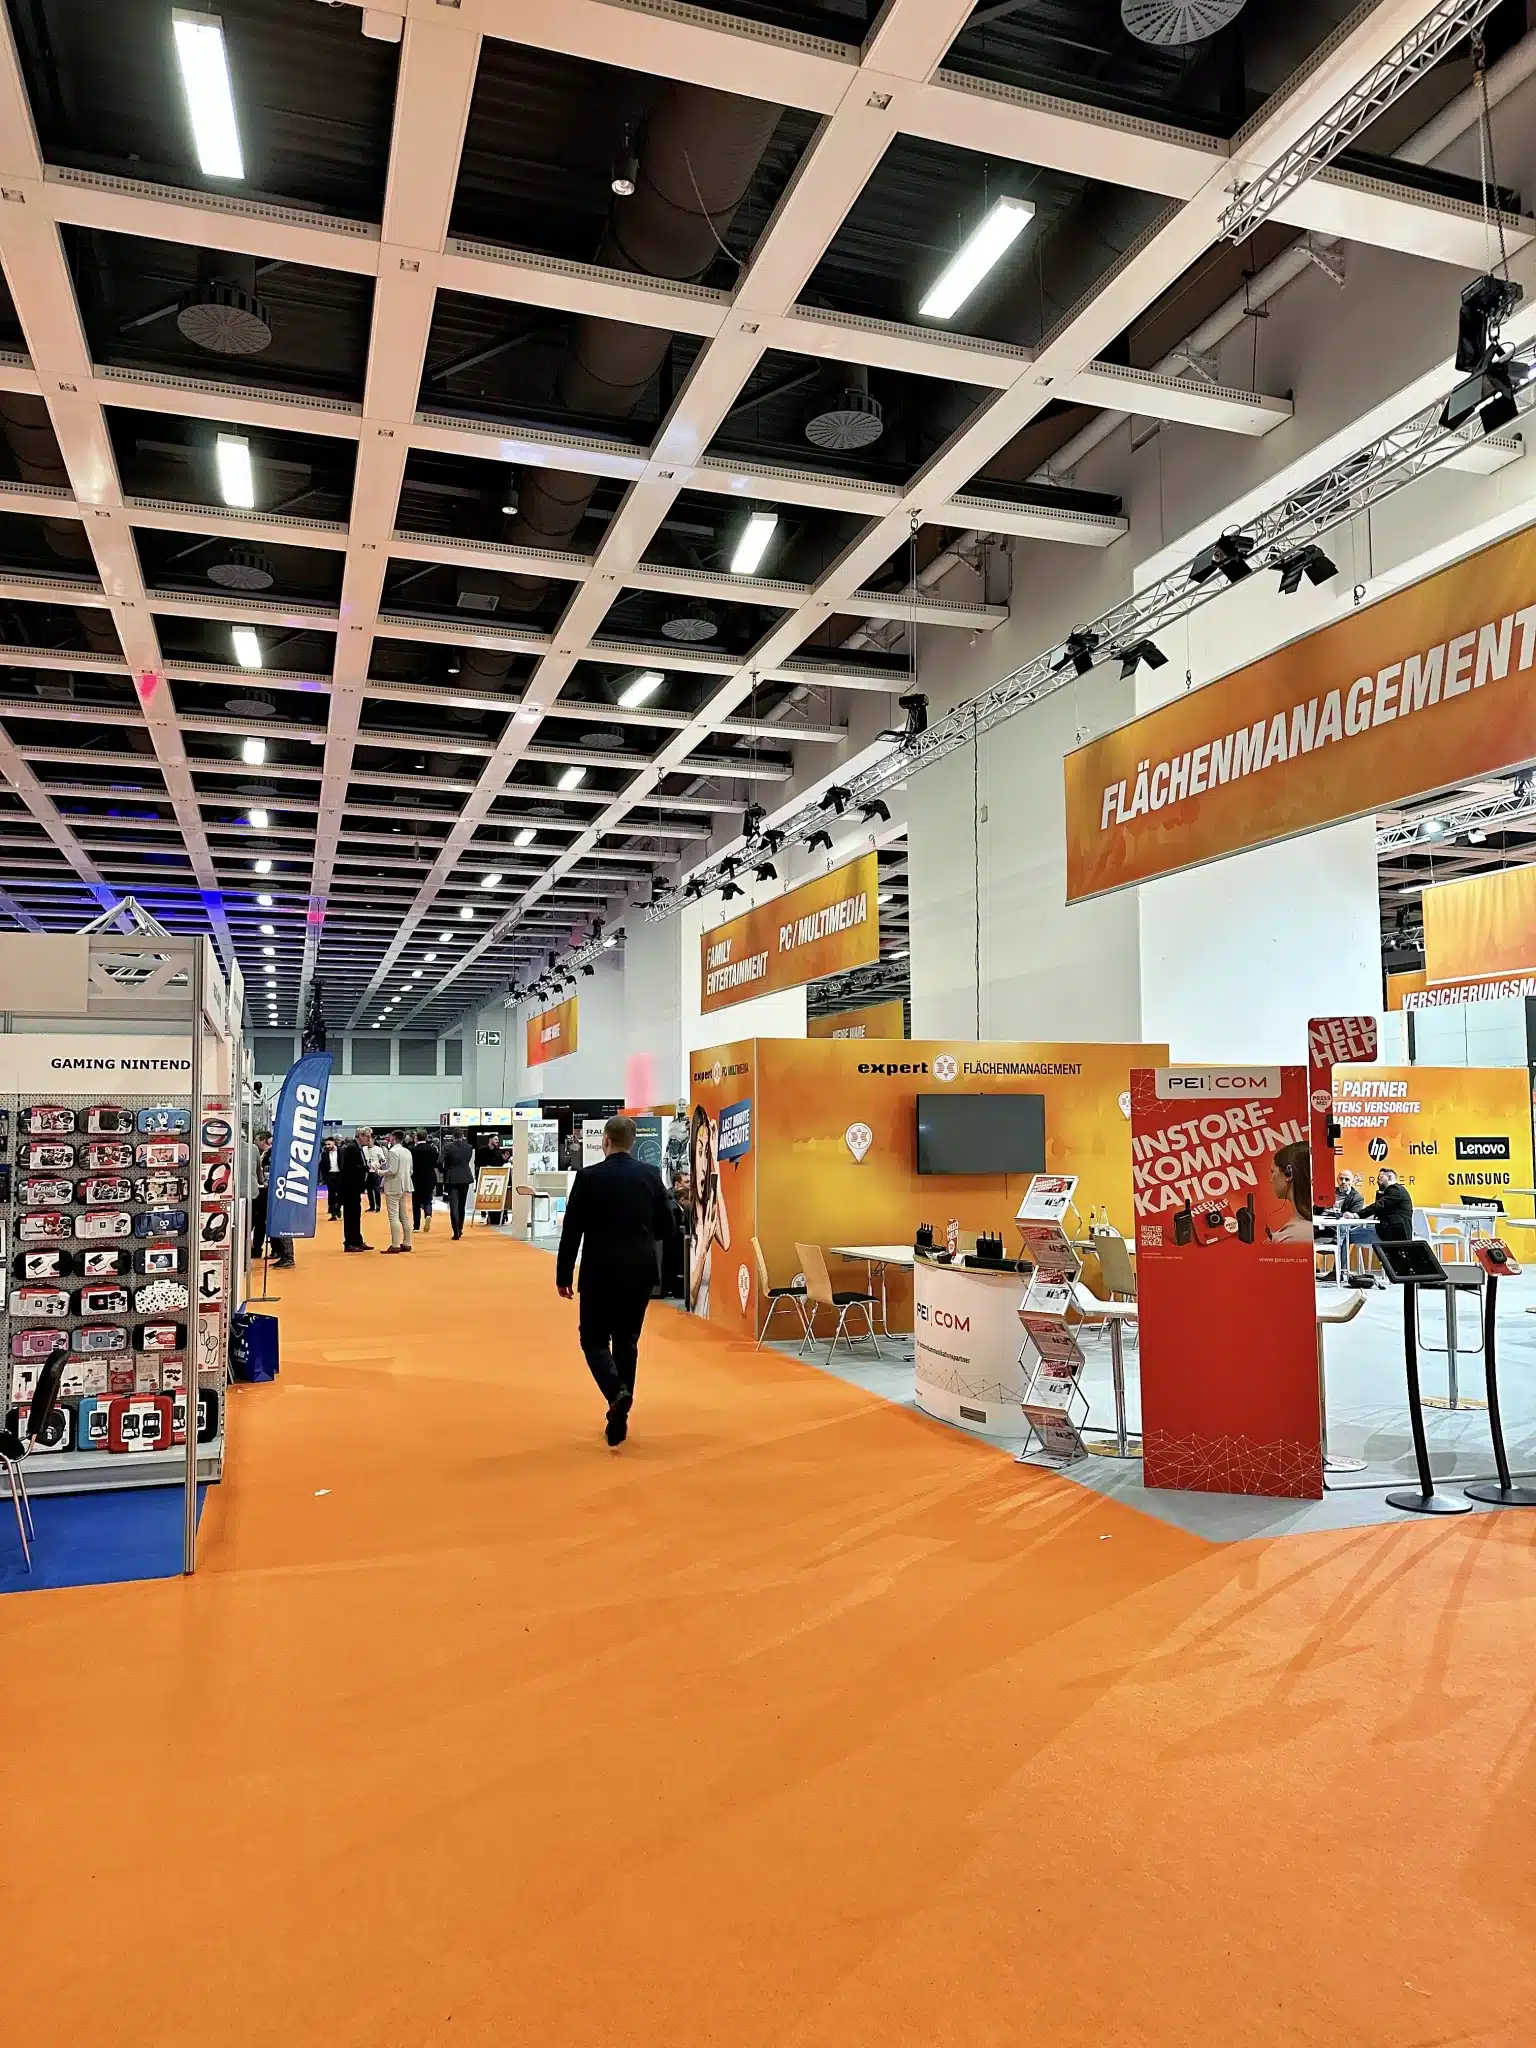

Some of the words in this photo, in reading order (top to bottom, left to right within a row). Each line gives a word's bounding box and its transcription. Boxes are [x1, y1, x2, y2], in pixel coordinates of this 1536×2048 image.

[1100, 603, 1536, 830] FLÄCHENMANAGEMENT
[778, 892, 867, 953] PC/MULTIMEDIA
[706, 938, 732, 970] FAMILY
[706, 951, 769, 996] ENTERTAINMENT
[1402, 977, 1536, 1011] VERSICHERUNGSM
[1308, 1016, 1377, 1049] NEED
[1311, 1031, 1377, 1068] HELP
[51, 1058, 115, 1070] GAMING
[121, 1059, 191, 1070] NINTEND
[857, 1061, 928, 1076] expert
[963, 1060, 1082, 1075] FLÄCHENMANAGEMENT
[1169, 1077, 1204, 1089] PEI
[1215, 1076, 1267, 1088] COM
[1342, 1081, 1408, 1097] PARTNER
[1364, 1101, 1420, 1113] VERSORGTE
[722, 1117, 733, 1131] LAST
[1131, 1101, 1274, 1161] INSTORE-
[719, 1123, 750, 1151] ANGEBOTE
[1459, 1141, 1506, 1155] Lenovo
[1133, 1119, 1309, 1189] KOMMUNI-
[1370, 1137, 1386, 1162] hp
[1133, 1161, 1258, 1217] KATION
[1368, 1175, 1416, 1186] RER
[1447, 1172, 1510, 1186] SAMSUNG
[1190, 1200, 1215, 1217] NEED
[1208, 1199, 1229, 1213] HELP
[1470, 1239, 1493, 1251] NEED
[934, 1310, 970, 1333] COM
